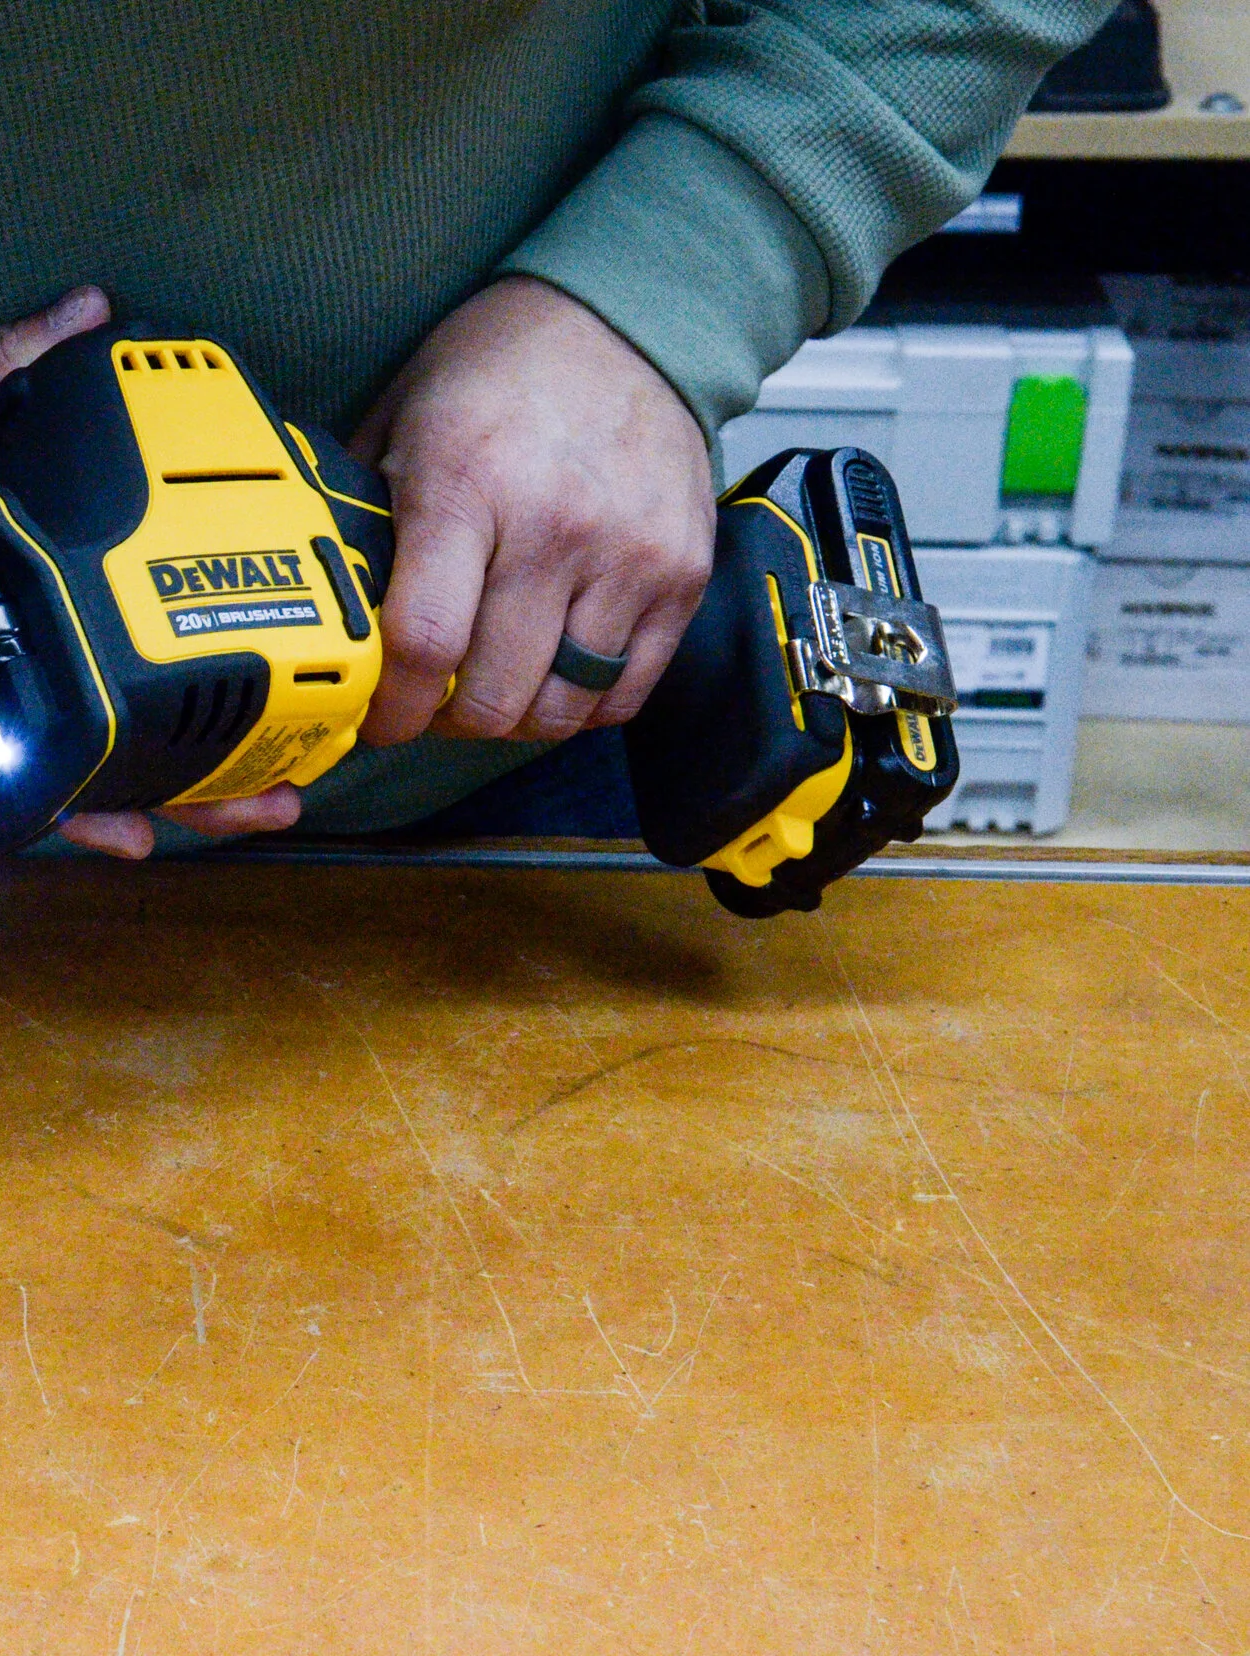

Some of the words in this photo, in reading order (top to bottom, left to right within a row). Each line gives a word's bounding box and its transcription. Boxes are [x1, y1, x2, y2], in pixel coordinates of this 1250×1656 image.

[870, 541, 883, 568] ION
[218, 607, 316, 624] BRUSHLESS
[906, 713, 926, 762] DEWAL
